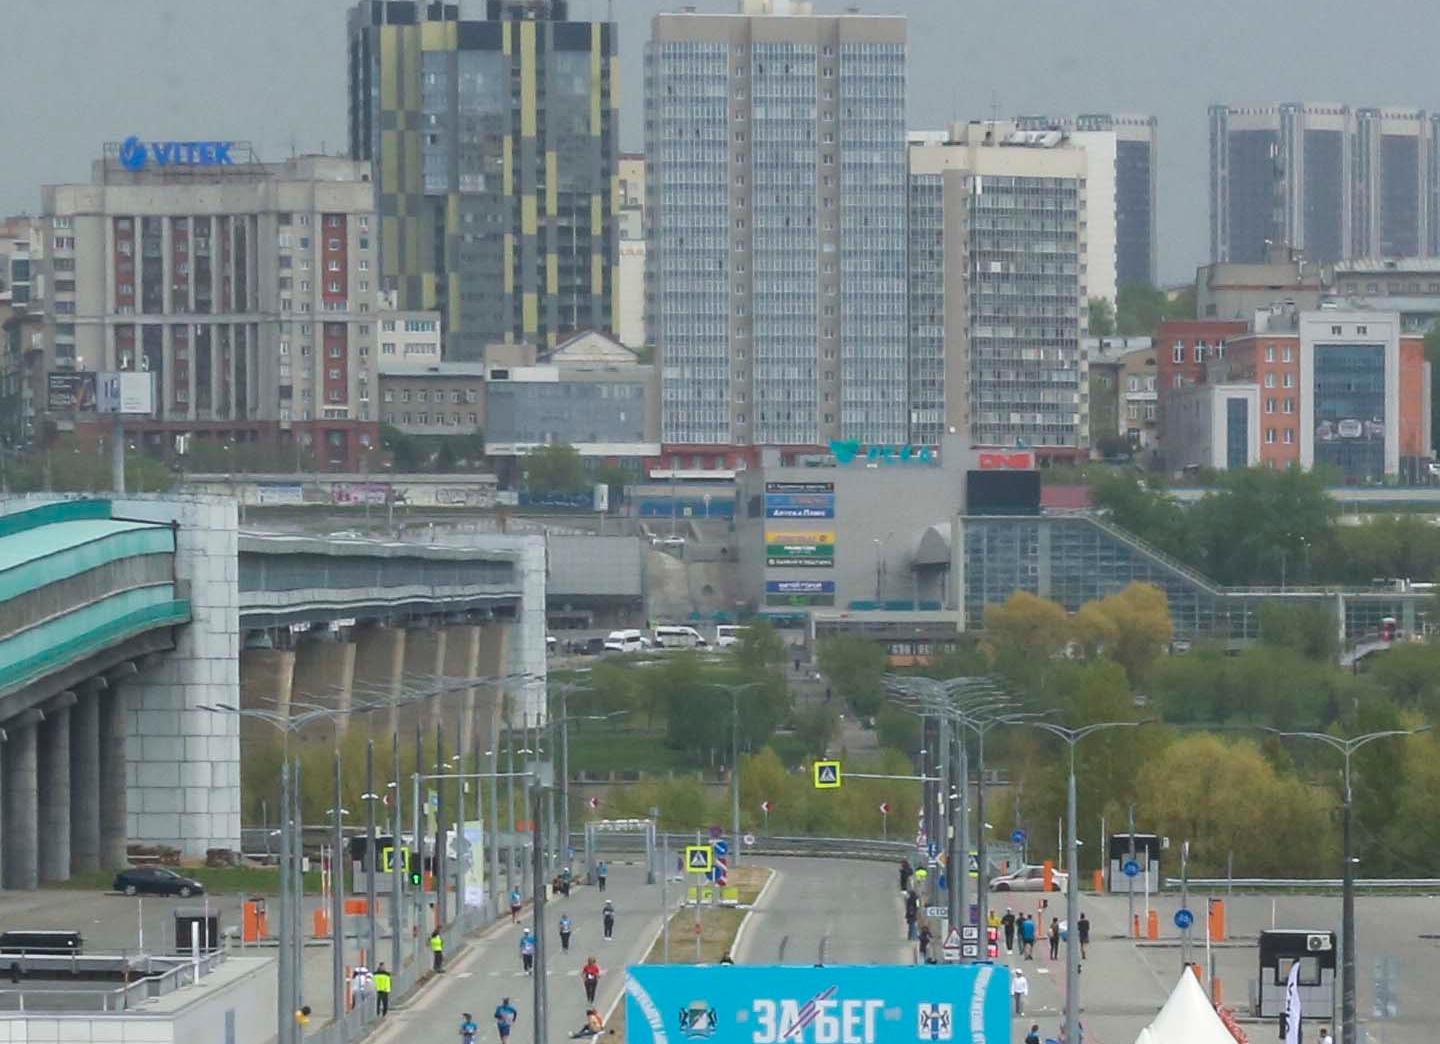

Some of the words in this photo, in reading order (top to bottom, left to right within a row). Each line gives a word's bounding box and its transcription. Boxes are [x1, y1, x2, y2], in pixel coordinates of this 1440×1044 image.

[152, 141, 236, 165] VITEK
[753, 999, 805, 1044] ЗА
[814, 999, 885, 1044] БЕГ
